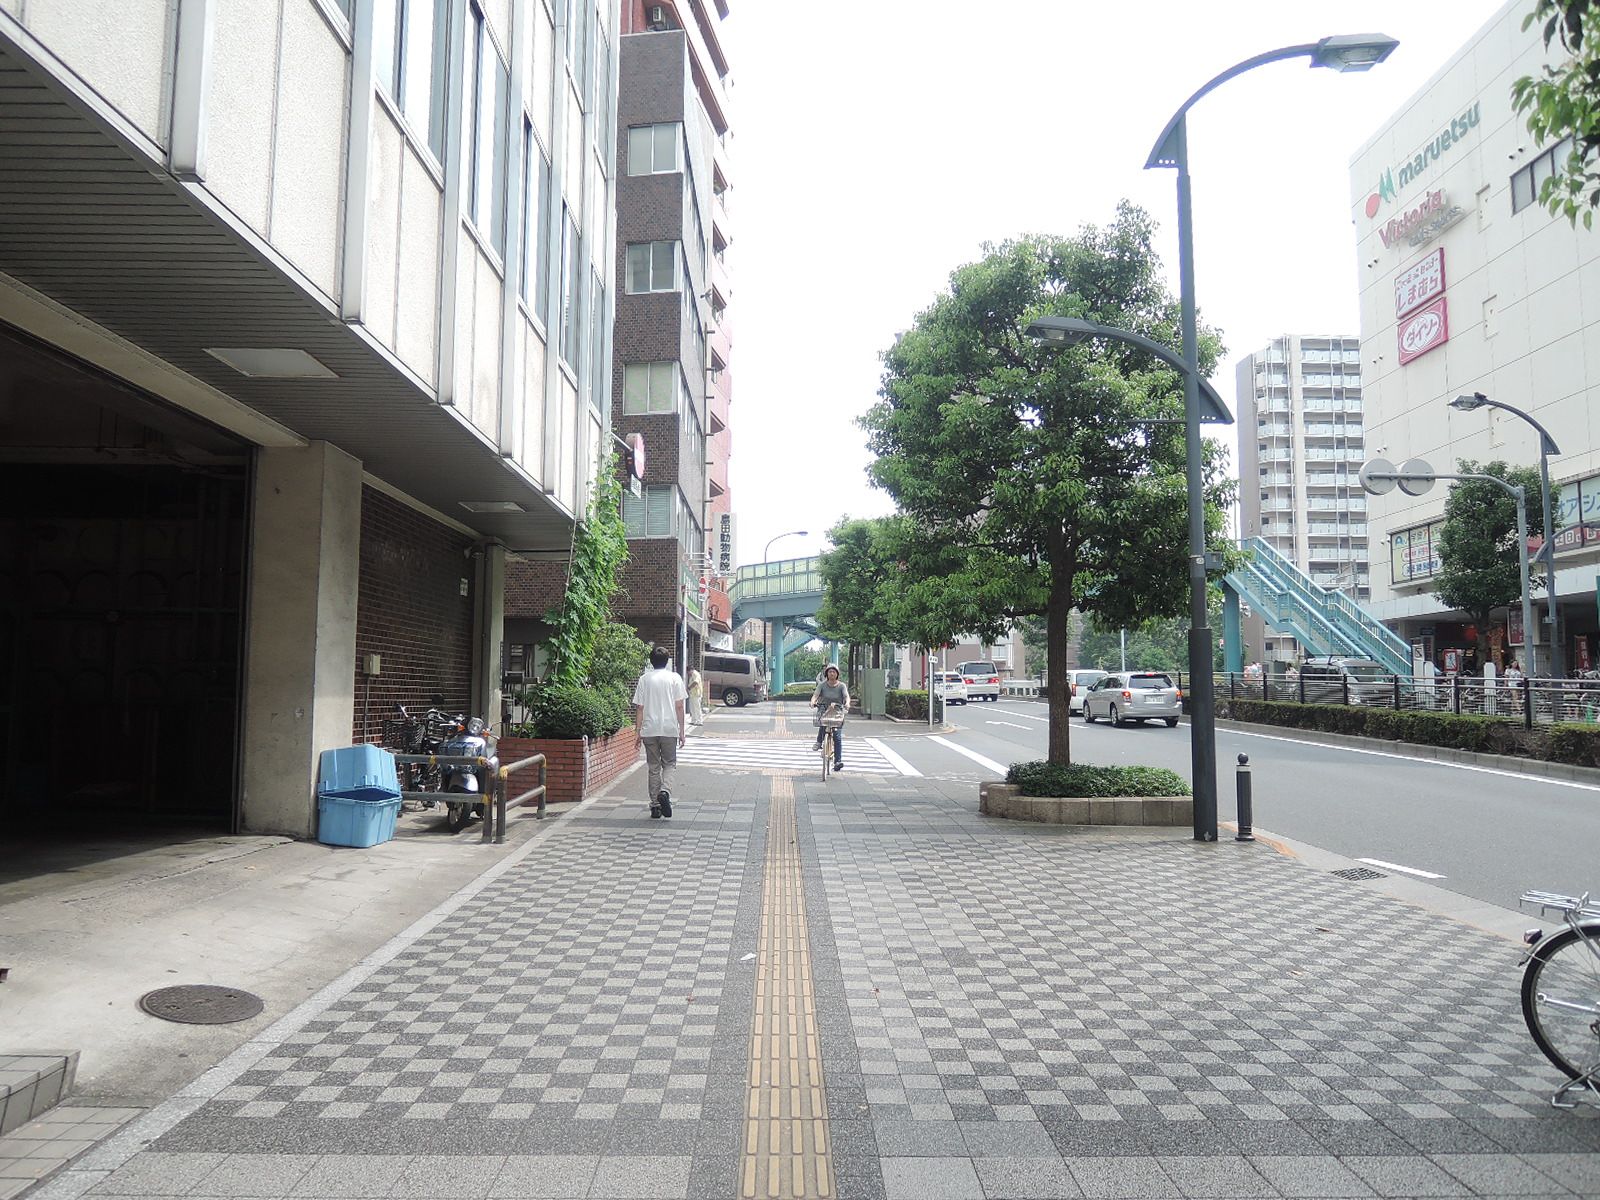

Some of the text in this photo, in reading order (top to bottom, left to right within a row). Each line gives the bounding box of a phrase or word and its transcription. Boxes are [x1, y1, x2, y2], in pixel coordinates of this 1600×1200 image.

[1398, 100, 1481, 189] maruetsu
[1378, 189, 1443, 249] Victoria
[1397, 268, 1439, 312] しまむら
